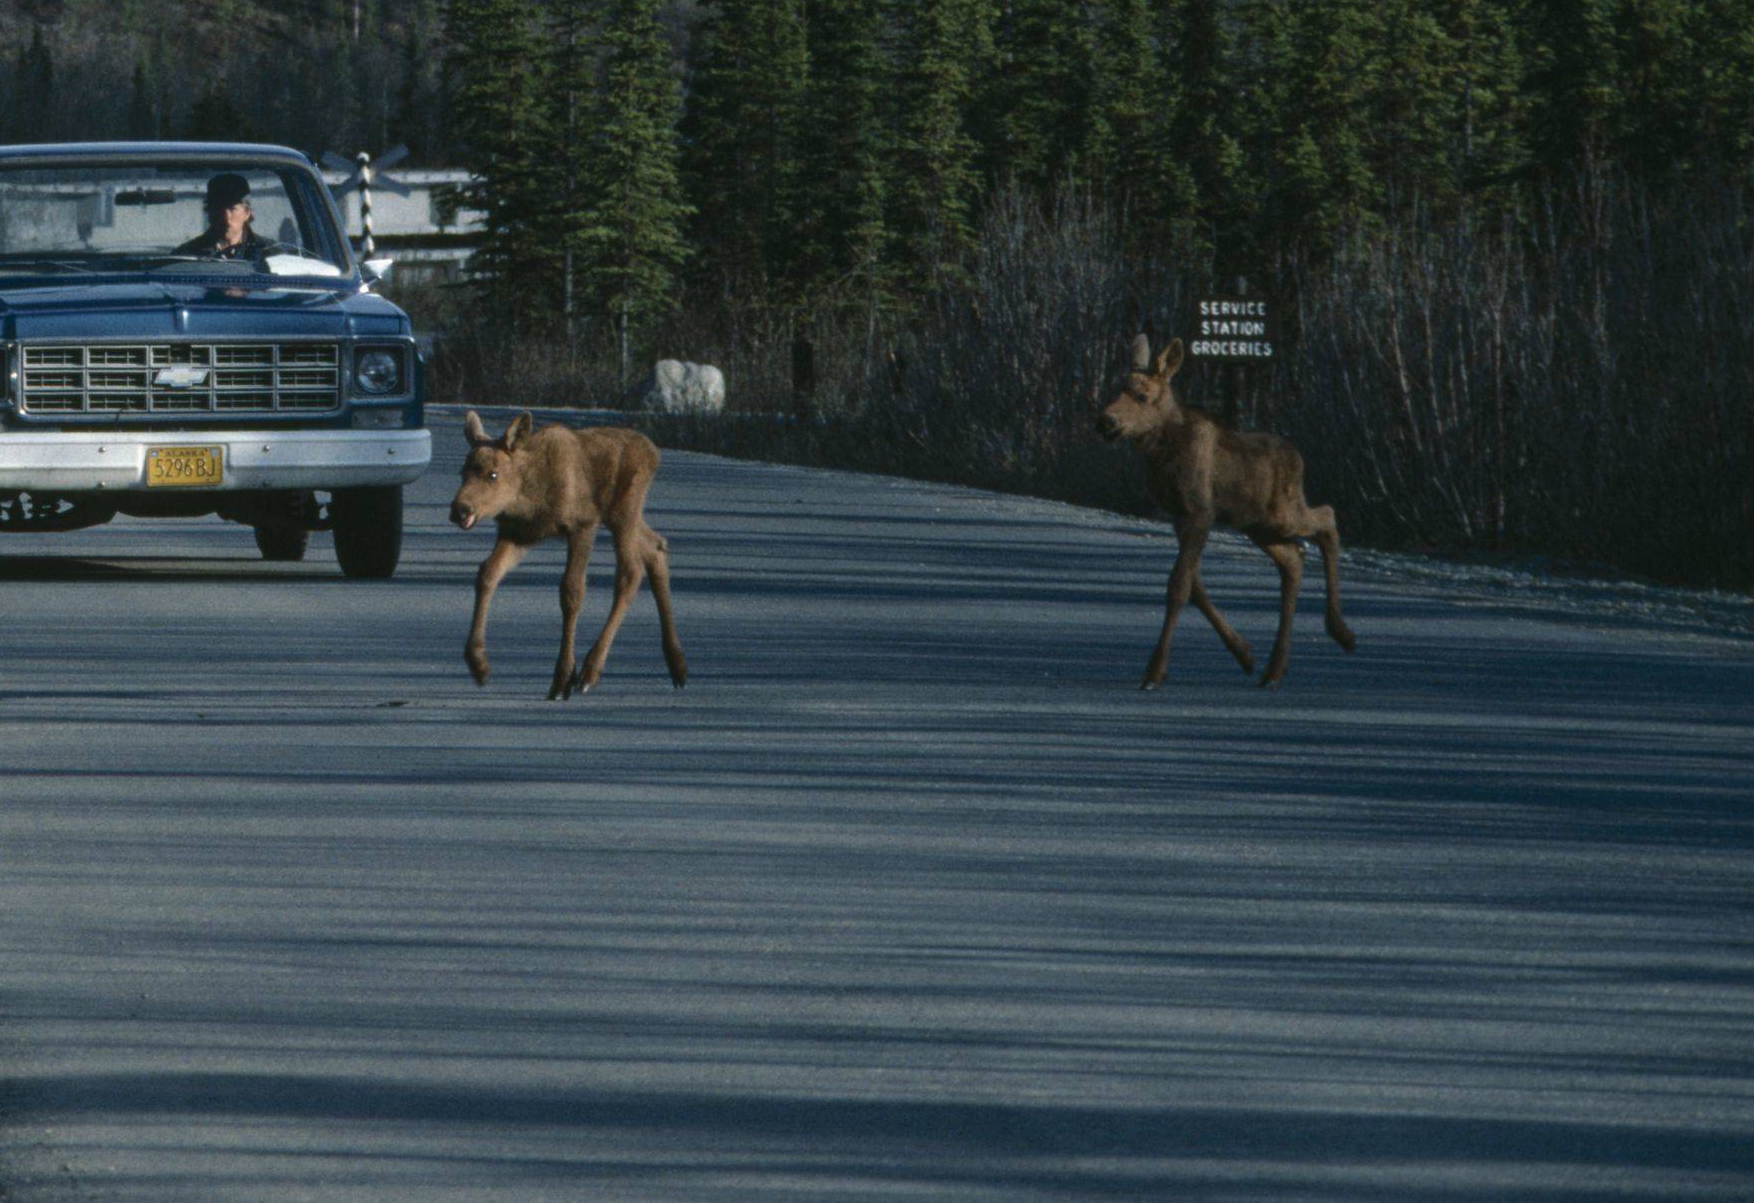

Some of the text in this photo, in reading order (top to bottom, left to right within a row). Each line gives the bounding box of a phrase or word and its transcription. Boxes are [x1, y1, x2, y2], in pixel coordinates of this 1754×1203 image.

[1199, 301, 1266, 315] SERVICE
[1201, 321, 1264, 335] STATION
[1191, 341, 1272, 356] GROCERIES
